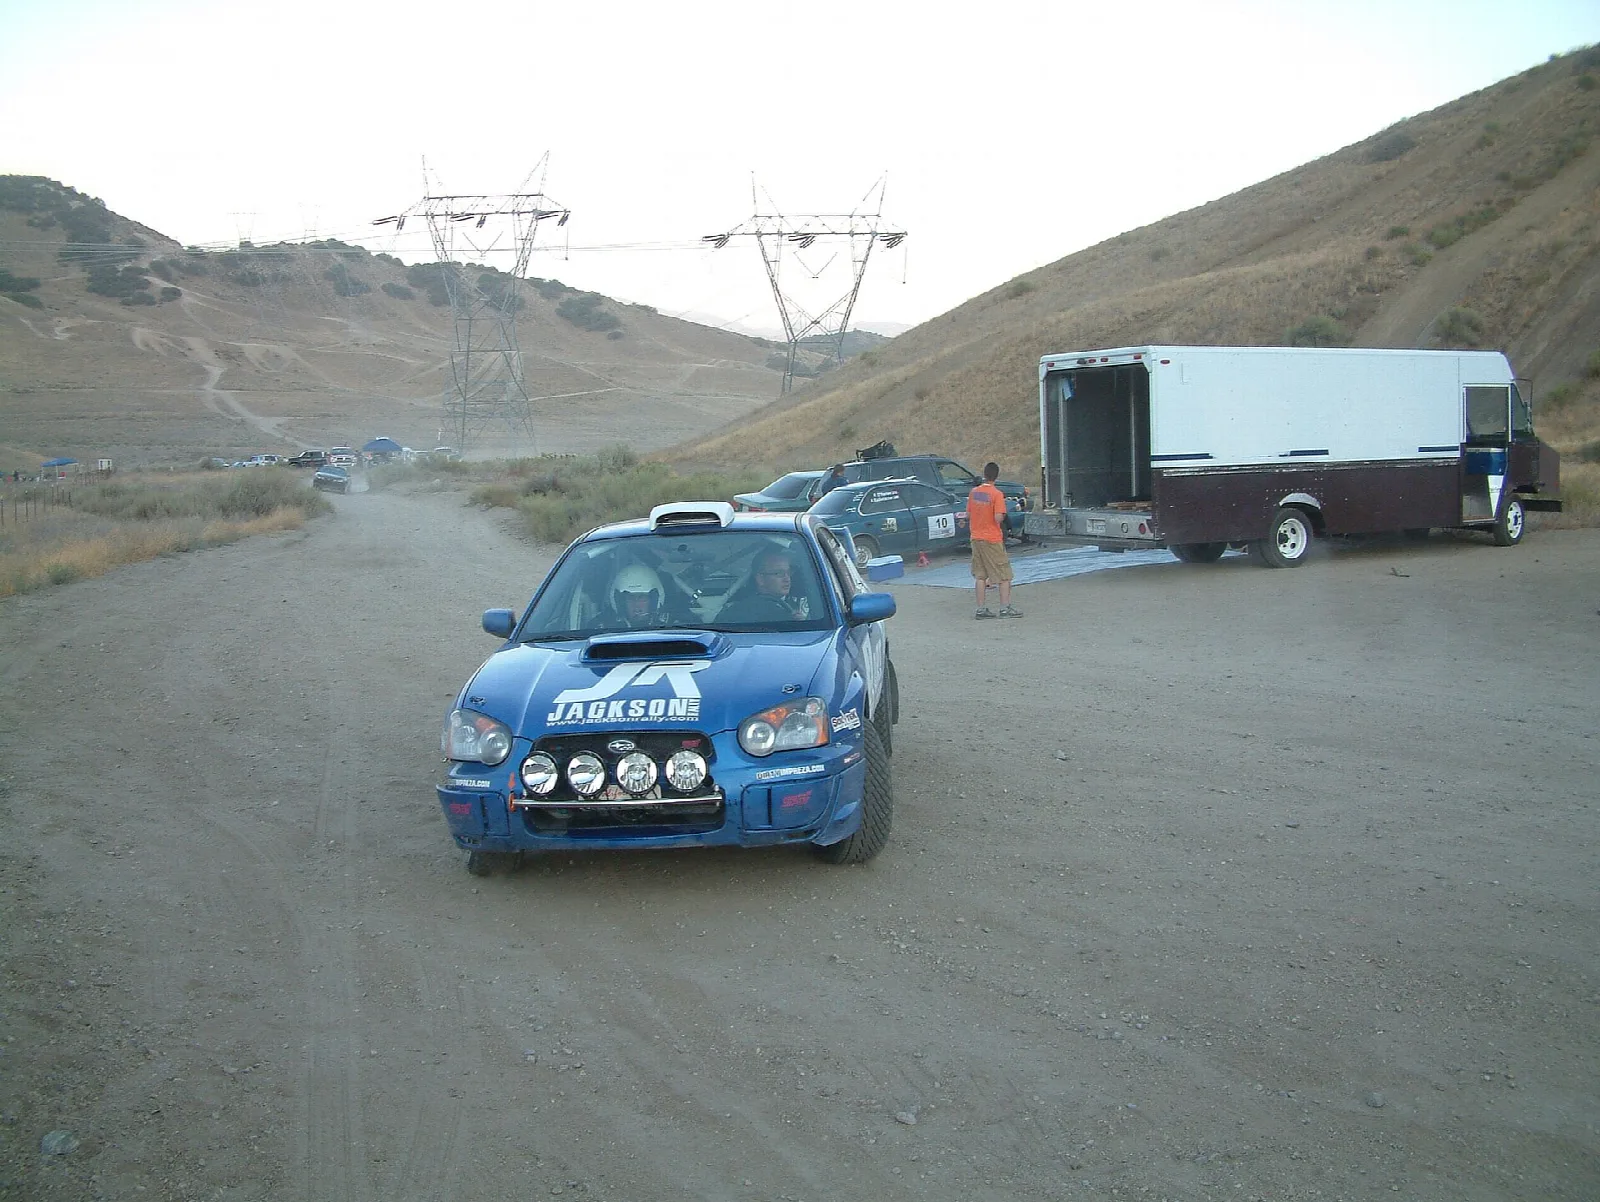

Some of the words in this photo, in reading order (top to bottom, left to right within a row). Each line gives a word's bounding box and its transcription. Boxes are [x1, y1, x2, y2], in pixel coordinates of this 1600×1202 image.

[936, 517, 948, 529] 10
[552, 660, 712, 704] JR
[547, 698, 688, 722] JACKSON
[546, 715, 700, 727] www.jacksonrally.com
